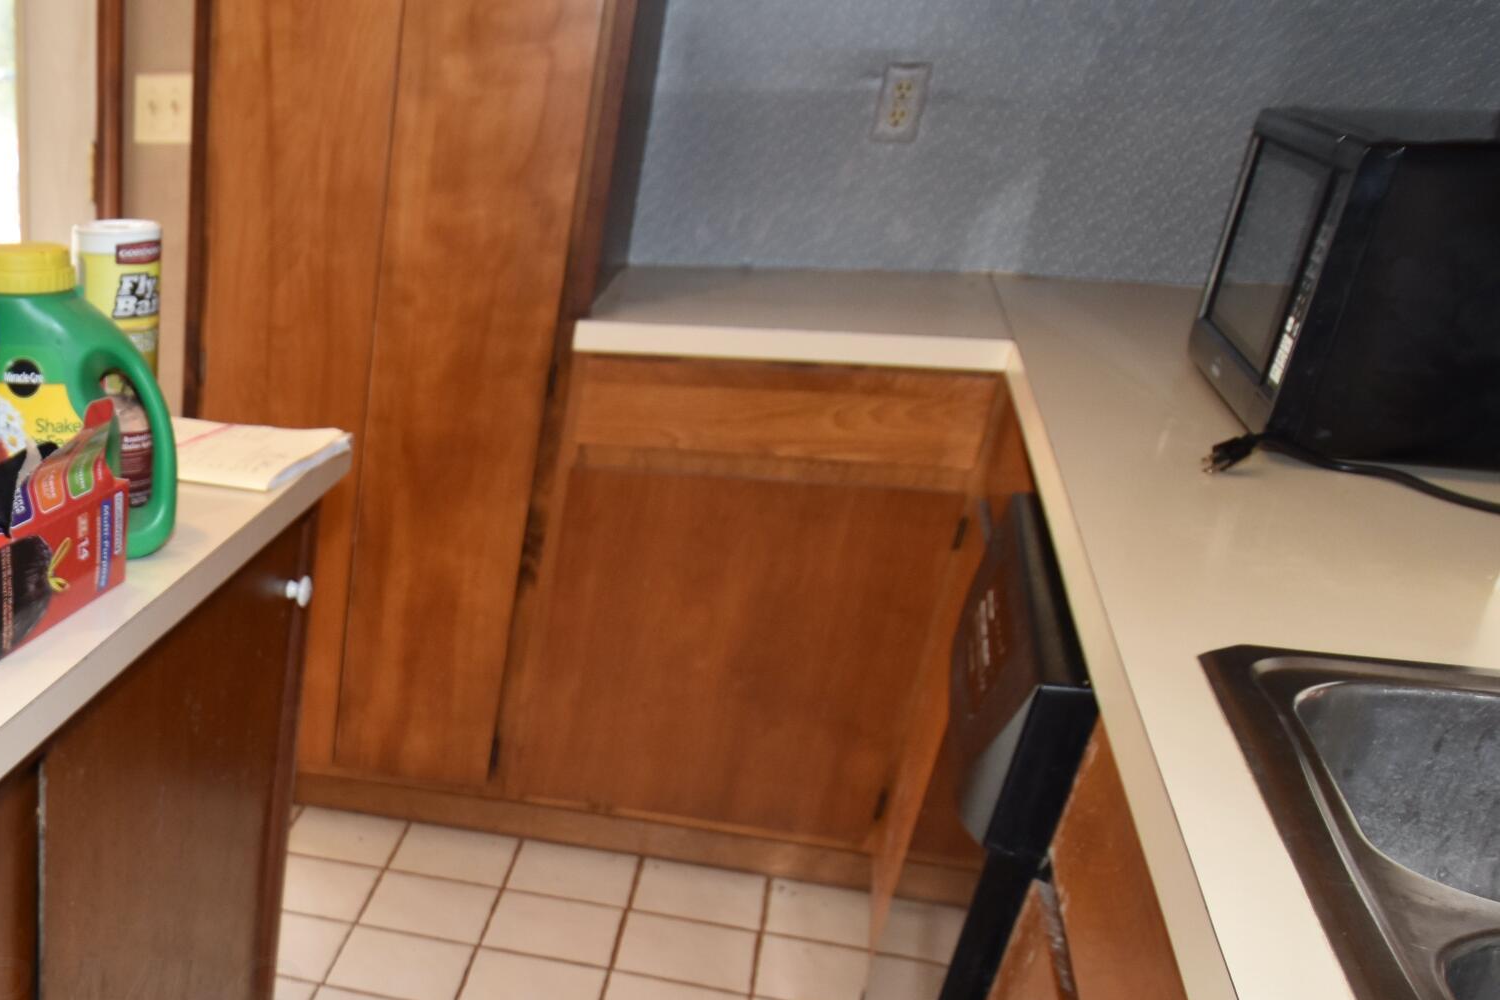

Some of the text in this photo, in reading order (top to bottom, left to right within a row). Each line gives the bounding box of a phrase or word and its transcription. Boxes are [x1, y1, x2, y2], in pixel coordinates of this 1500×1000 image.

[118, 273, 157, 299] Fly
[113, 293, 159, 317] Bai
[35, 417, 81, 433] Shake
